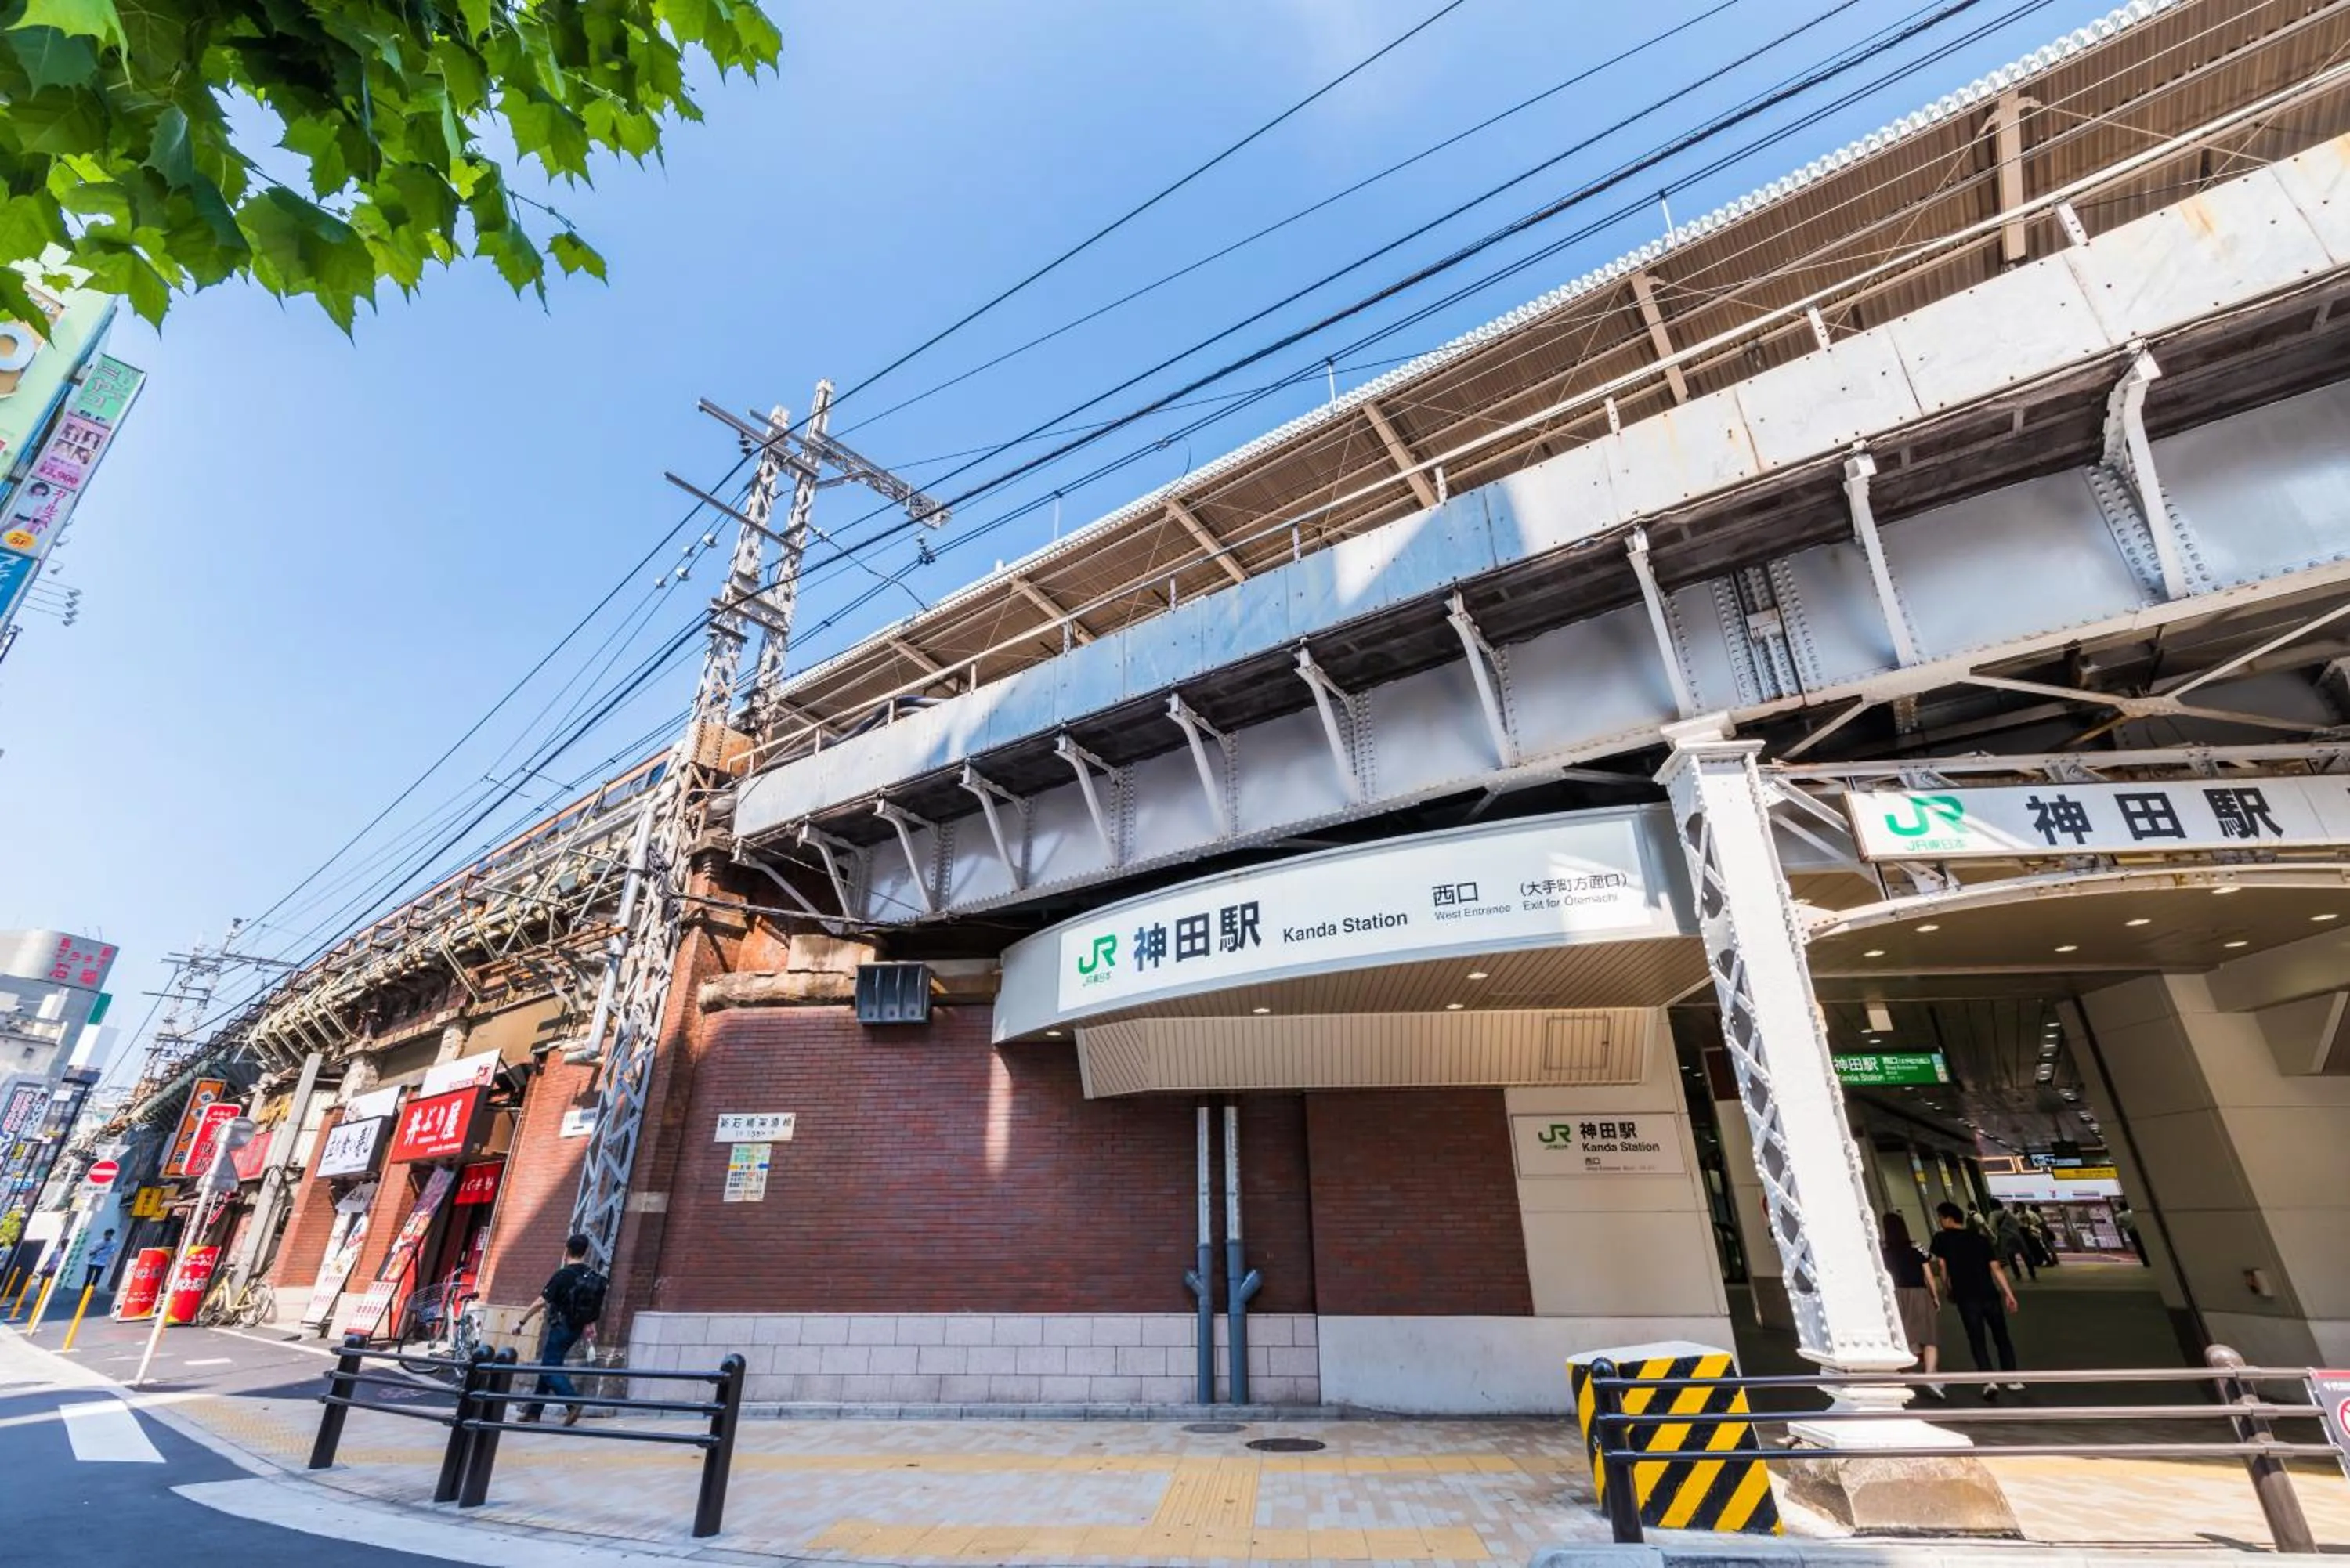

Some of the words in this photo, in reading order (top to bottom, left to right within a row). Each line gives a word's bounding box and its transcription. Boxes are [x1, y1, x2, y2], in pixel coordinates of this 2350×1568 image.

[1884, 796, 1969, 836] JR
[2026, 786, 2284, 846] 神田駅
[1432, 881, 1480, 907] 西口
[1523, 899, 1545, 911] Exit
[1546, 898, 1560, 908] for
[1434, 909, 1461, 921] West
[1464, 905, 1511, 917] Entrance
[1133, 900, 1262, 972] 神田駅
[1283, 921, 1337, 943] Kanda
[1343, 912, 1408, 934] Station
[1079, 934, 1117, 974] JR
[1833, 1057, 1879, 1072] 神田駅
[1538, 1125, 1571, 1143] JR
[1579, 1122, 1637, 1140] 神田駅
[1582, 1143, 1617, 1152] Kanda
[1621, 1143, 1660, 1152] Station
